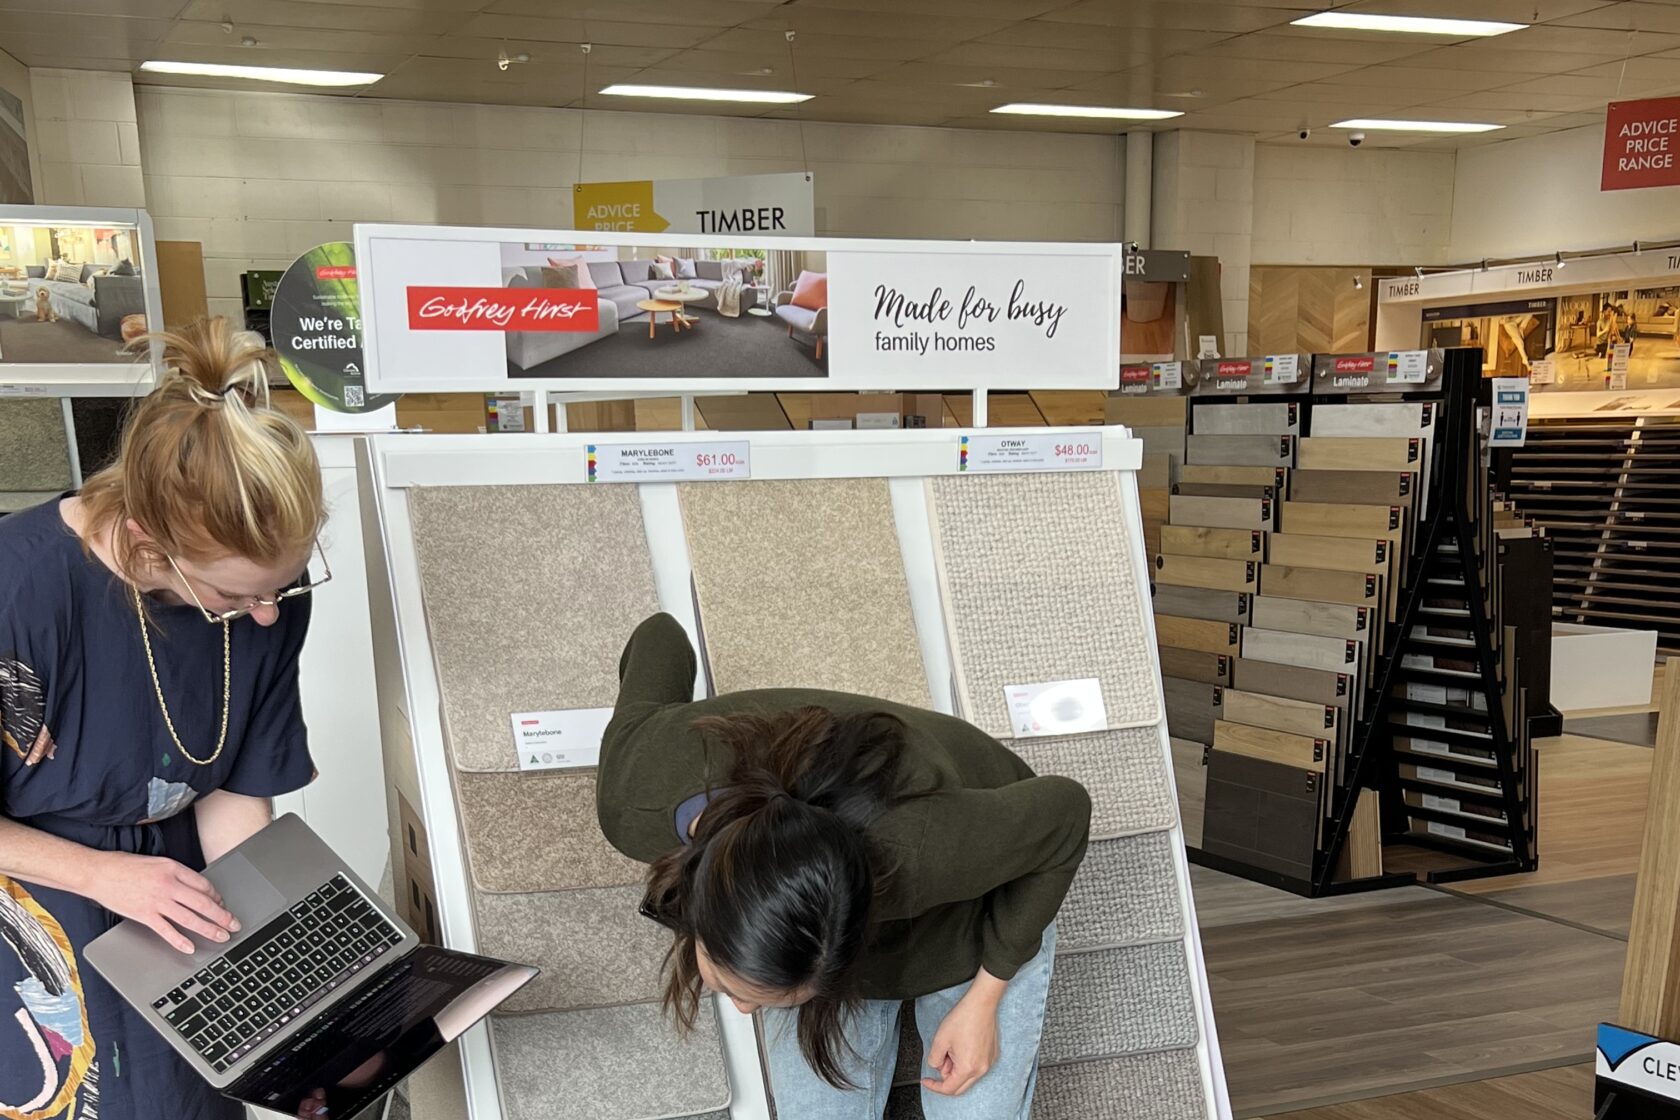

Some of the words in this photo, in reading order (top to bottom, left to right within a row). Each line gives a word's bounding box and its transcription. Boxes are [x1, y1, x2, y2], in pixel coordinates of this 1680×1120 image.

[1619, 119, 1678, 137] ADVICE
[1626, 137, 1669, 154] PRICE
[1618, 154, 1673, 171] RANGE
[587, 203, 641, 219] ADVICE
[595, 221, 634, 232] PRICE
[696, 207, 786, 234] TIMBER
[1517, 269, 1553, 284] TIMBER
[1389, 283, 1420, 298] TIMBER
[419, 296, 515, 326] Godfrey
[521, 297, 593, 320] Hirst
[874, 284, 953, 328] Made
[958, 286, 1001, 330] for
[1007, 279, 1068, 338] busy
[299, 316, 343, 331] We're
[346, 316, 363, 330] Ta
[292, 334, 357, 350] Certified
[875, 331, 929, 356] family
[935, 332, 995, 351] homes
[1121, 383, 1147, 393] Laminate
[1217, 379, 1247, 389] Laminate
[1333, 375, 1369, 387] Laminate
[1001, 440, 1026, 448] OTWAY
[1055, 444, 1089, 456] $48.00
[621, 449, 674, 457] MARYLEBONE
[696, 453, 736, 466] $61.00
[523, 729, 562, 737] Marylebone
[1643, 1056, 1680, 1082] CLE
